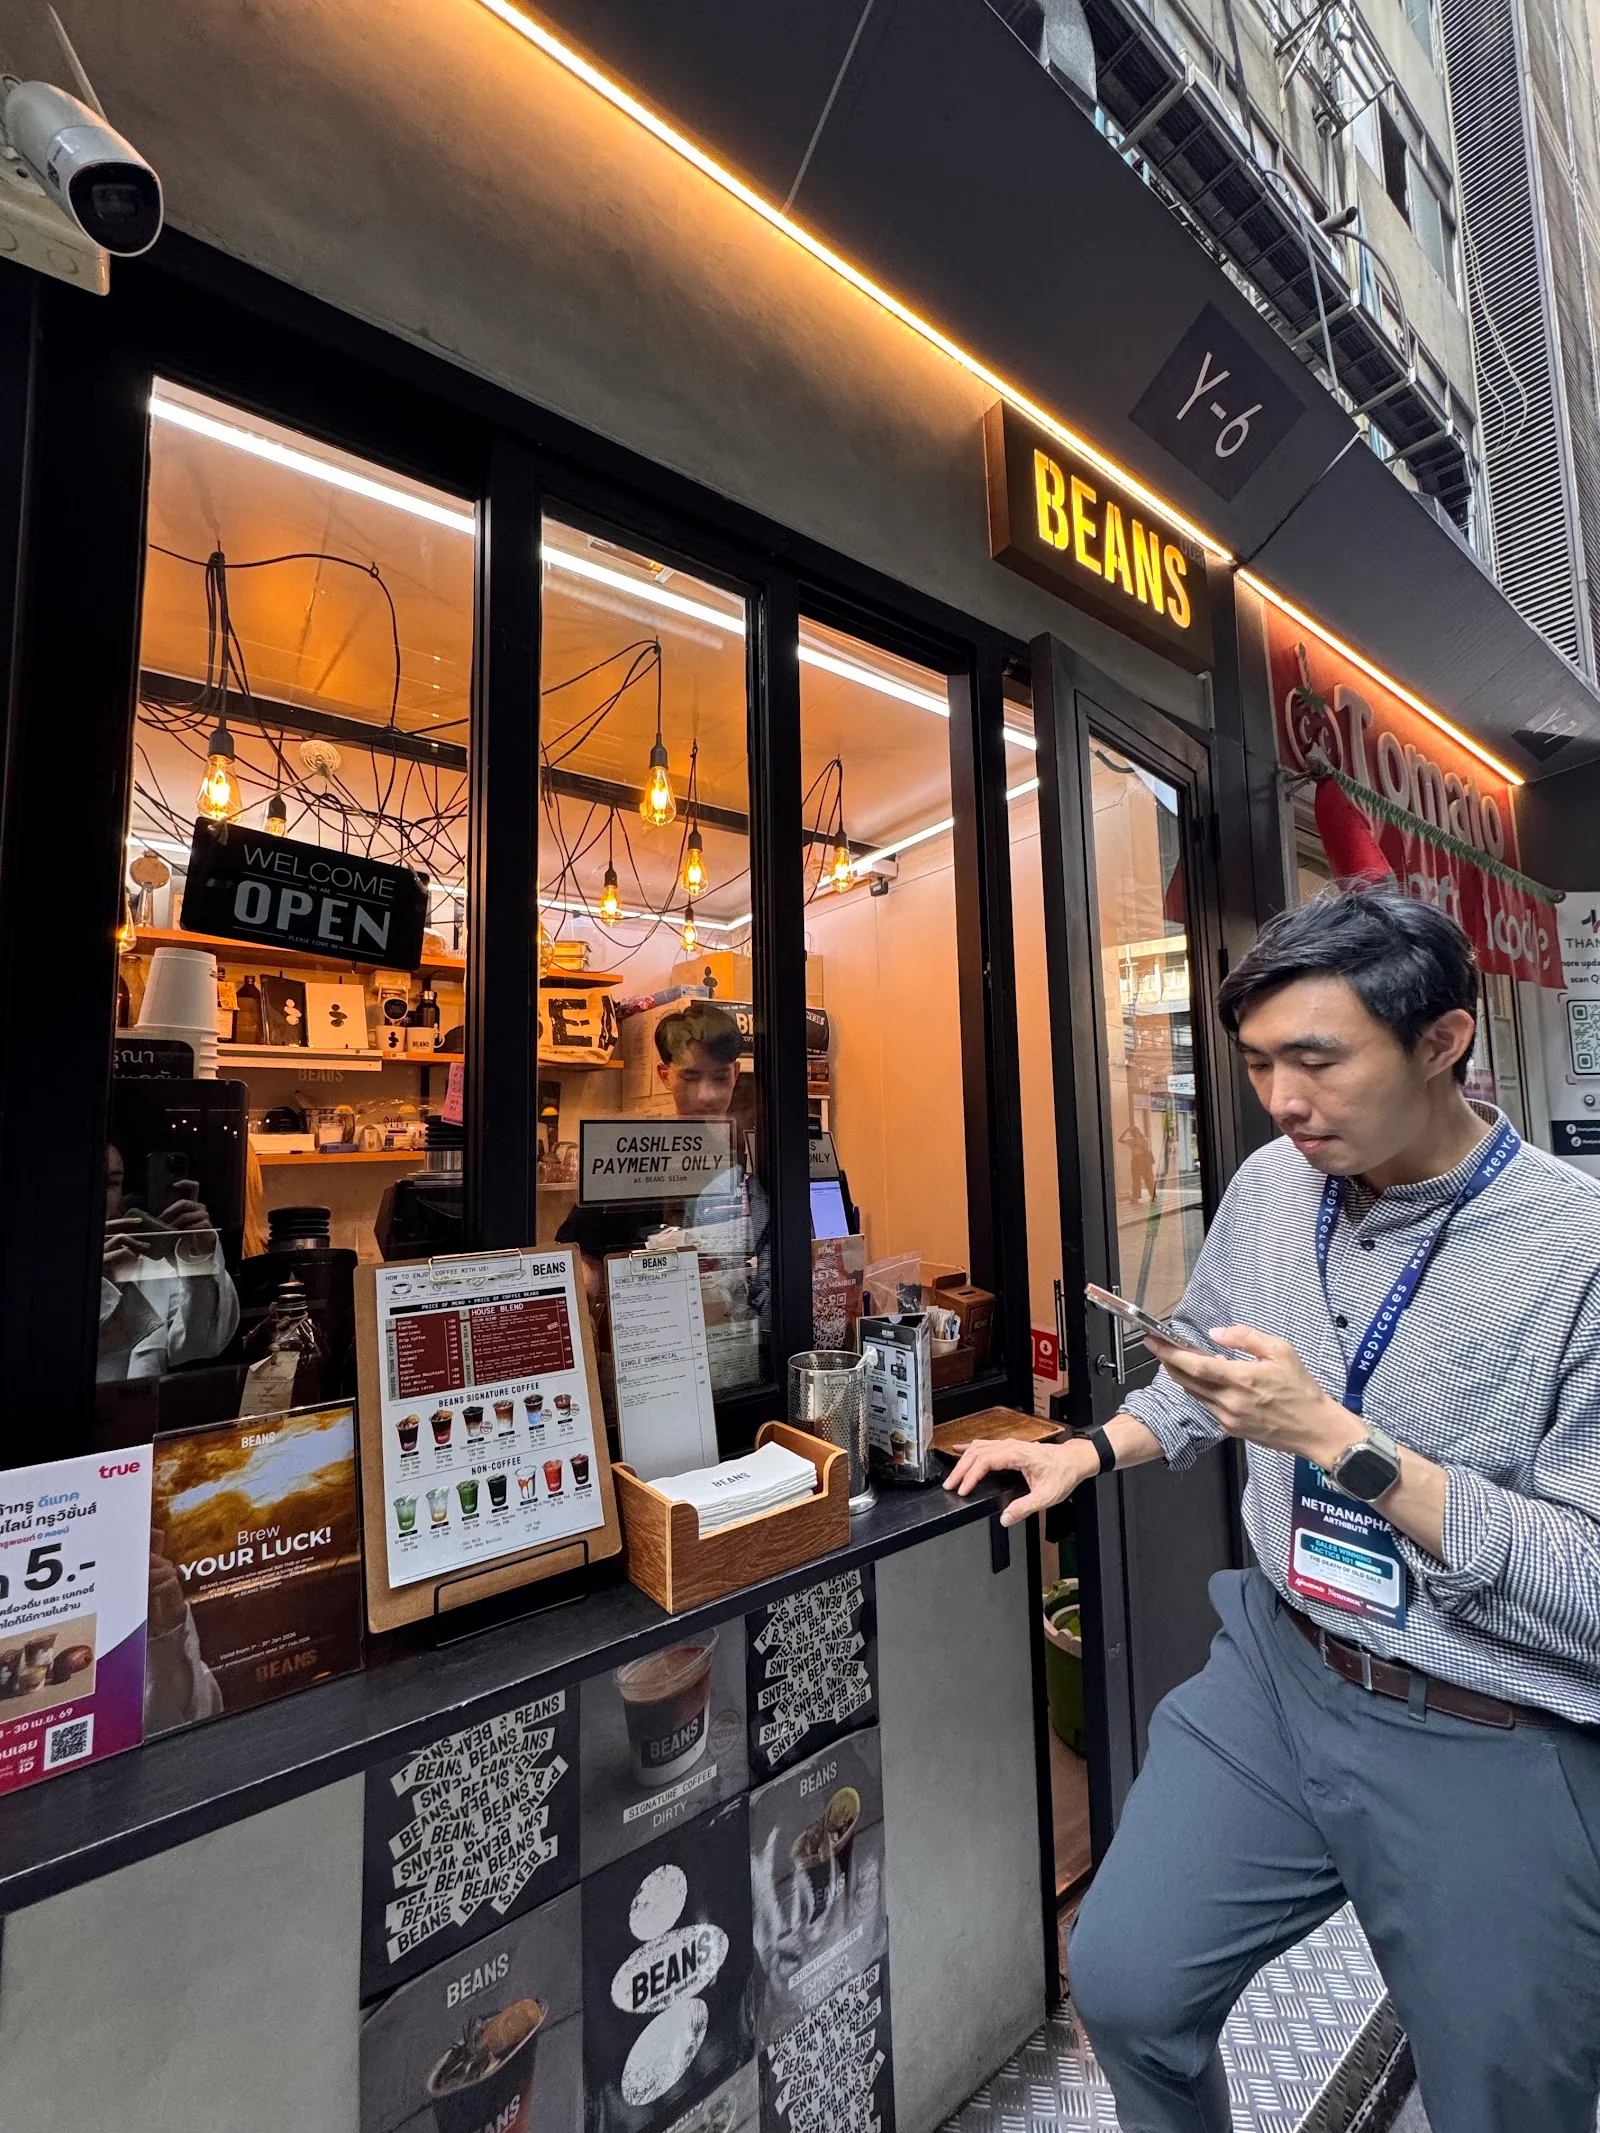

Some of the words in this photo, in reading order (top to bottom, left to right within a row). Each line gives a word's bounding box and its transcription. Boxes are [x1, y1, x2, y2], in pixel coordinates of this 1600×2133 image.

[1176, 352, 1263, 458] Y-6
[1034, 449, 1191, 628] BEANS
[1334, 684, 1505, 861] Tomato
[244, 844, 397, 900] WELCOME
[233, 879, 392, 950] OPEN
[1571, 976, 1588, 984] scan
[616, 1136, 703, 1153] CASHLESS
[592, 1156, 669, 1175] PAYMENT
[681, 1154, 723, 1171] ONLY
[645, 1175, 665, 1183] BEANS
[668, 1174, 688, 1182] Silom
[533, 1261, 566, 1277] BEANS
[642, 1257, 667, 1269] BEANS
[614, 1278, 635, 1286] SINGLE
[638, 1274, 667, 1282] SPECIALTY
[471, 1307, 496, 1316] HOUSE
[500, 1303, 524, 1312] BLEND
[620, 1359, 641, 1368] SINGLE
[644, 1352, 678, 1363] COMMERCIAL
[439, 1395, 464, 1408] BEANS
[467, 1386, 509, 1403] SIGNATURE
[512, 1381, 540, 1395] COFFEE
[241, 1432, 276, 1449] BEANS
[99, 1461, 141, 1479] true
[471, 1456, 521, 1476] NON-COFFEE
[711, 1472, 751, 1488] BEANS
[38, 1491, 80, 1508] ดีแทค
[36, 1502, 97, 1527] ทรูวิชั่นส์
[1323, 1515, 1369, 1536] ARTHIBUTR
[237, 1525, 280, 1546] Brew
[179, 1547, 254, 1582] YOUR
[261, 1526, 332, 1561] LUCK!
[1310, 1544, 1341, 1561] TACTICS
[1341, 1554, 1354, 1566] 101
[1315, 1540, 1338, 1552] SALES
[1339, 1547, 1372, 1564] WINNING
[199, 1581, 219, 1591] BEANS
[219, 1575, 245, 1586] members
[257, 1567, 274, 1577] spend
[1309, 1554, 1321, 1563] THE
[1321, 1558, 1342, 1572] DEATH
[1342, 1565, 1351, 1573] OF
[1351, 1568, 1364, 1578] OLD
[1365, 1573, 1382, 1584] SALE
[43, 1594, 60, 1606] และ
[240, 1587, 259, 1597] BEANS
[220, 1651, 235, 1660] Valid
[236, 1646, 251, 1655] from
[282, 1631, 297, 1640] 2026
[224, 1651, 265, 1669] announcement
[794, 1686, 823, 1718] BEANS
[839, 1689, 866, 1718] BEANS
[13, 1722, 29, 1735] 30
[59, 1707, 74, 1719] 69
[470, 1727, 518, 1769] BEANS
[650, 1718, 699, 1759] BEANS
[630, 1787, 678, 1817] SIGNATURE
[682, 1768, 713, 1792] COFFEE
[800, 1761, 837, 1798] BEANS
[482, 1782, 529, 1822] BEANS
[653, 1799, 688, 1827] DIRTY
[489, 1831, 534, 1873] BEANS
[462, 1873, 510, 1900] BEANS
[398, 1904, 451, 1951] BEANS
[446, 1952, 510, 2008] BEANS
[632, 1929, 711, 2010] BEANS
[803, 1953, 849, 1996] ESPRESSO
[795, 2010, 828, 2047] BEANS
[821, 2000, 850, 2037] BEANS
[832, 2077, 861, 2120] BEANS
